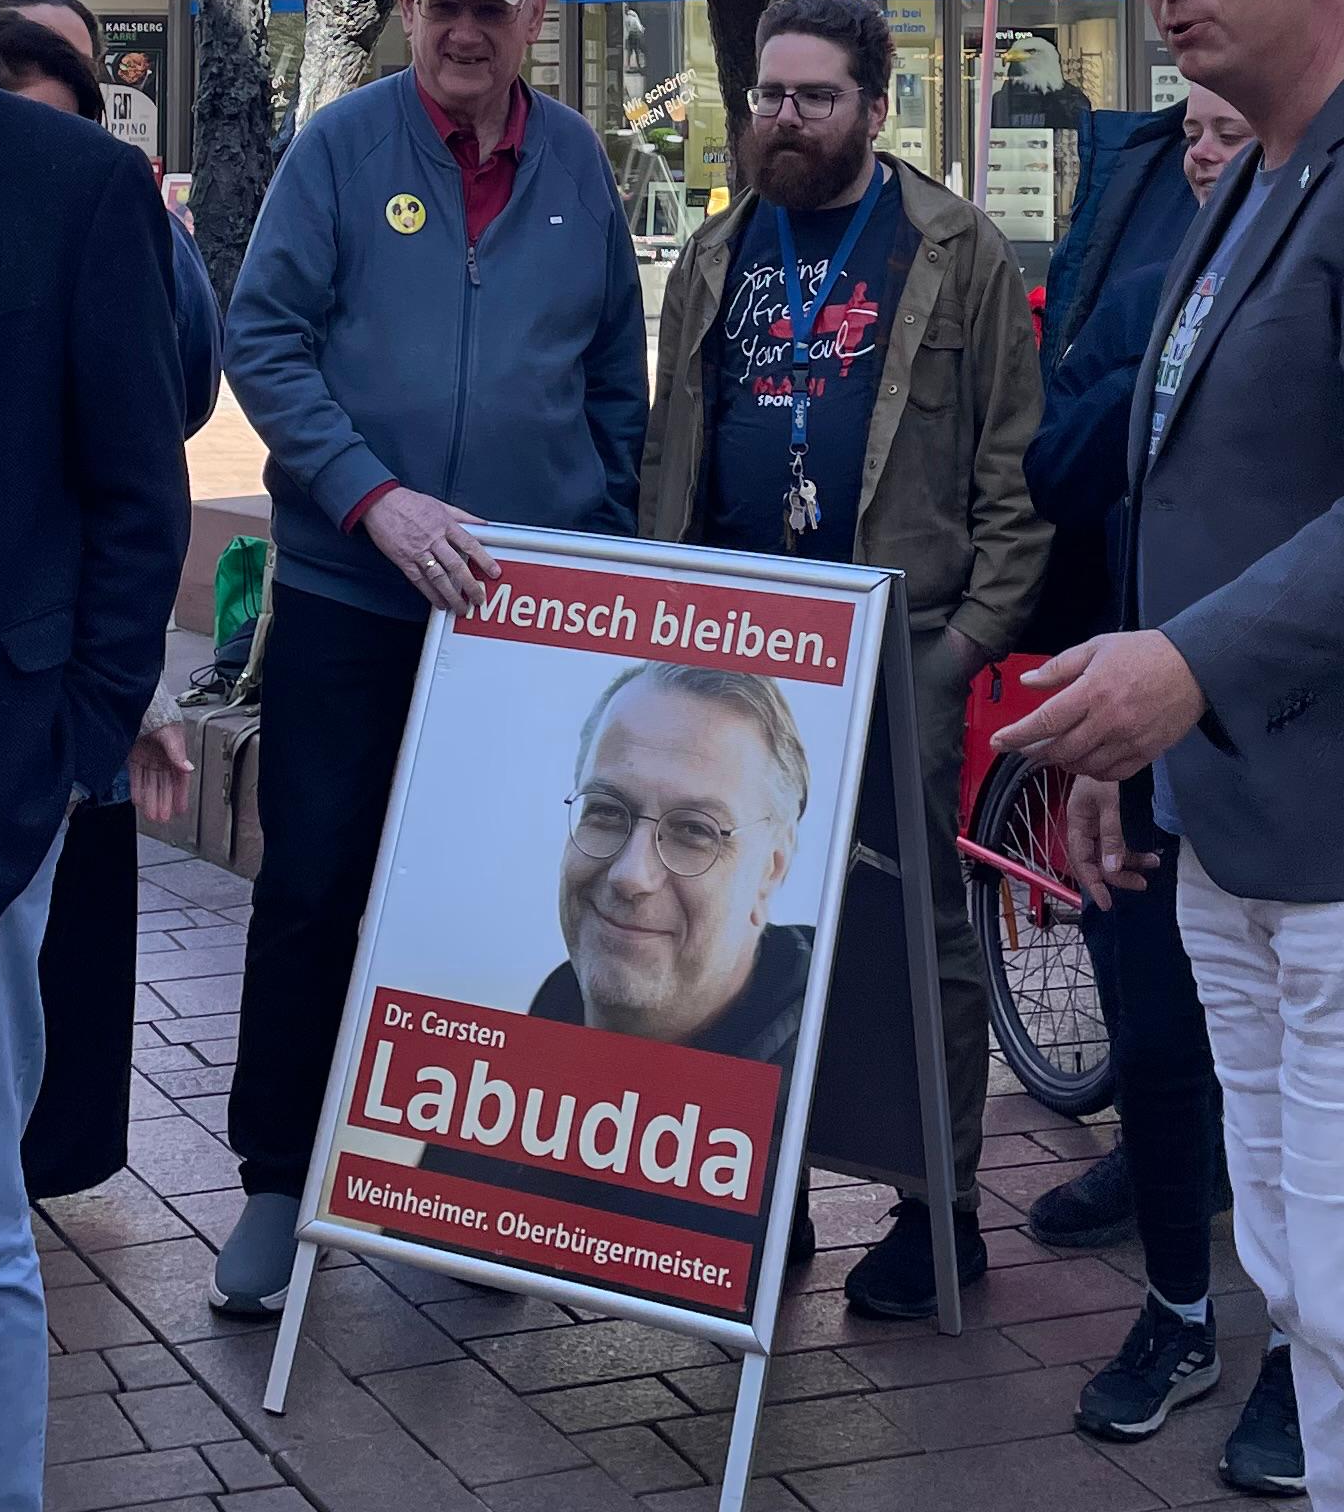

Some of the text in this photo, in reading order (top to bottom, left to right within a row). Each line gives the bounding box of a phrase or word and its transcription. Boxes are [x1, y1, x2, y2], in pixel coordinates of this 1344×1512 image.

[105, 22, 163, 33] KARLSBERG
[623, 68, 697, 115] Wir schärfen
[629, 85, 699, 133] IHREN BLICK
[809, 320, 876, 359] oul
[757, 394, 811, 407] SPORS
[464, 581, 838, 669] Mensch bleiben.
[384, 1003, 506, 1049] Dr. Carsten
[363, 1040, 754, 1201] Labudda
[346, 1175, 733, 1289] Weinheimer. Oberbürgermeister.
